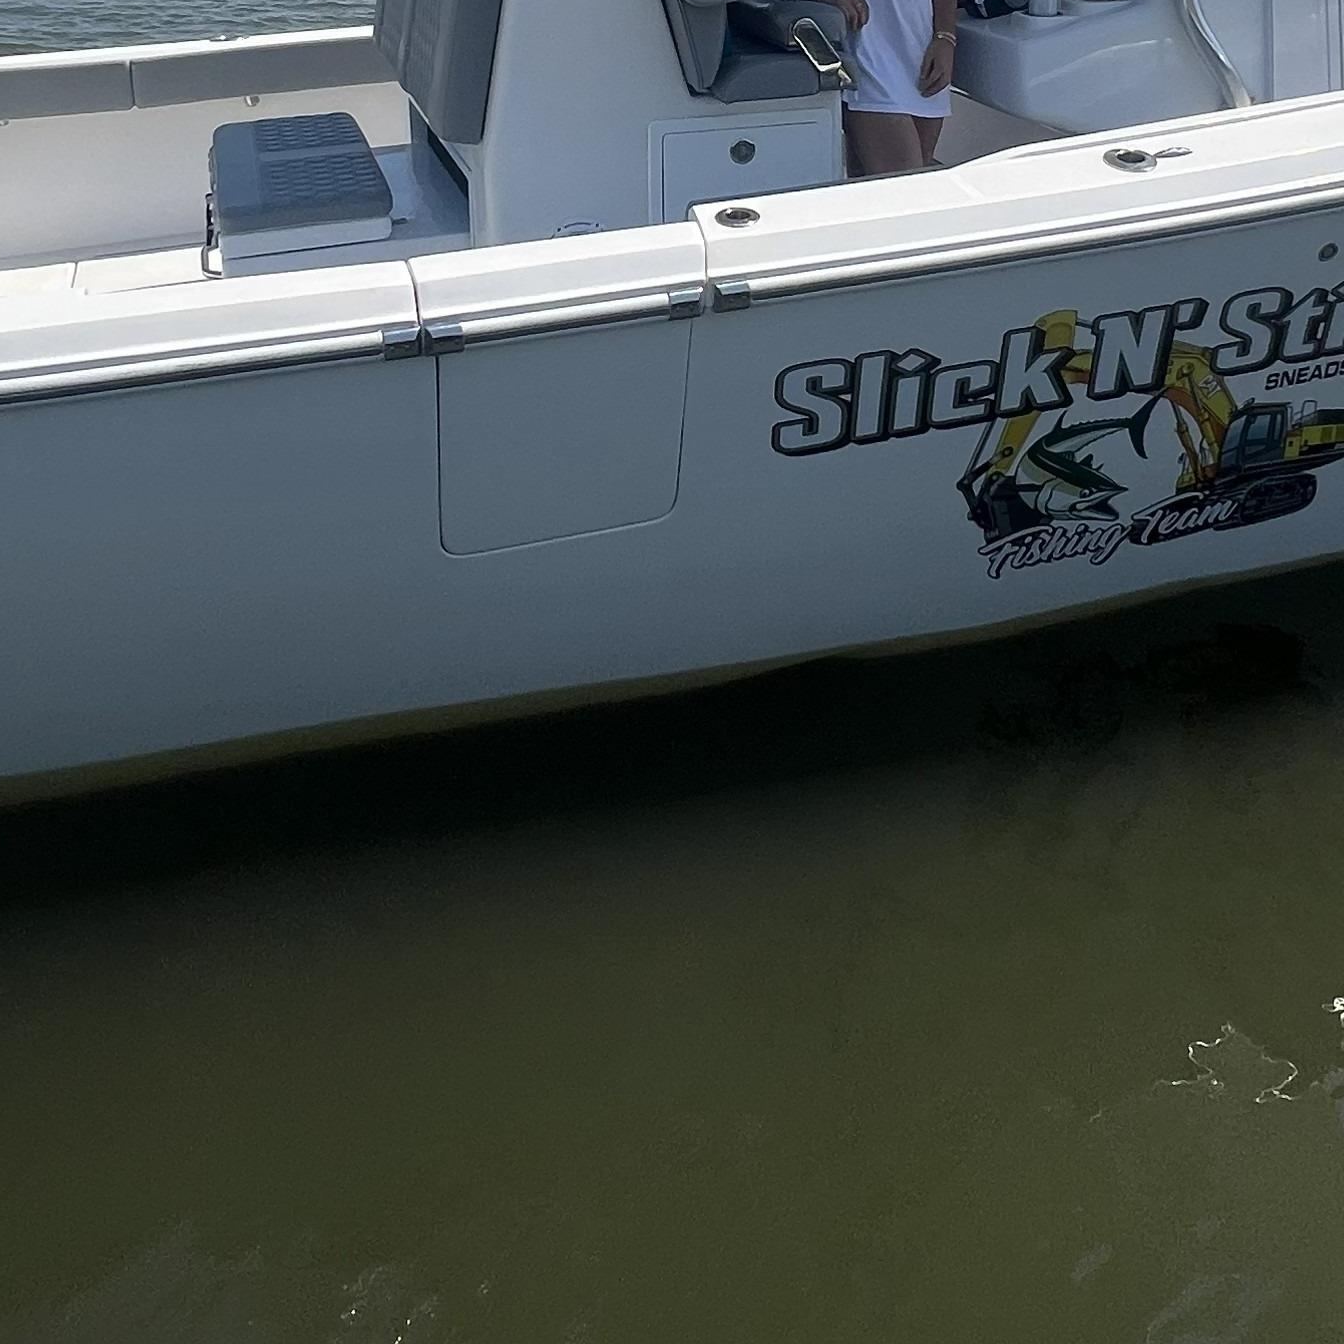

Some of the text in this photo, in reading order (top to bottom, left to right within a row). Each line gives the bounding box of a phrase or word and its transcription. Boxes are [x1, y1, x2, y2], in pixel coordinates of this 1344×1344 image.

[771, 325, 1076, 457] Slick
[1086, 297, 1209, 402] N'
[978, 491, 1238, 579] Fishing Team
